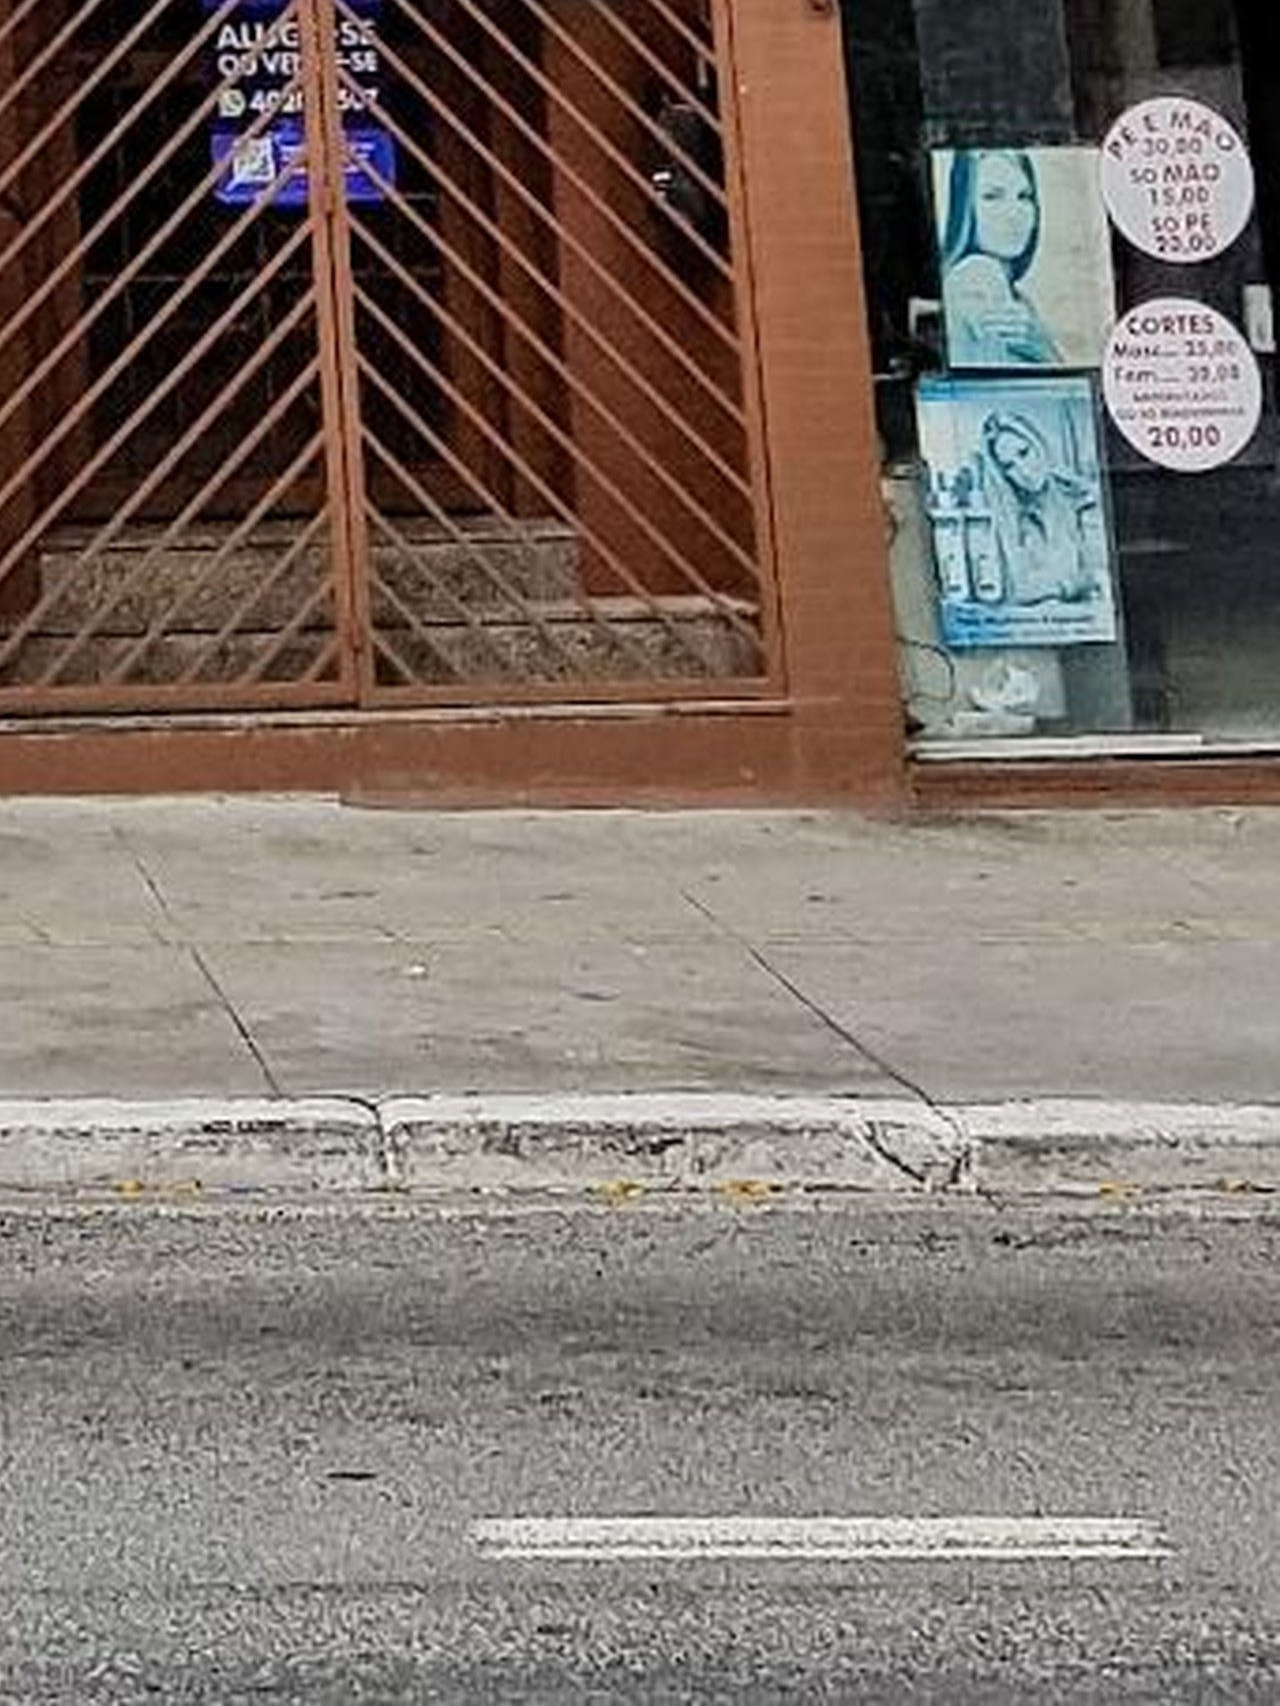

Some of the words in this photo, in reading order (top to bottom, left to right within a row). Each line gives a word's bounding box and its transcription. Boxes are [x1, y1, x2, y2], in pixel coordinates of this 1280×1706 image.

[217, 21, 378, 50] ALUG-SE
[217, 52, 258, 77] OU
[260, 50, 379, 73] VE-SE
[1126, 314, 1215, 336] CORTES
[1147, 424, 1222, 451] 20,00
